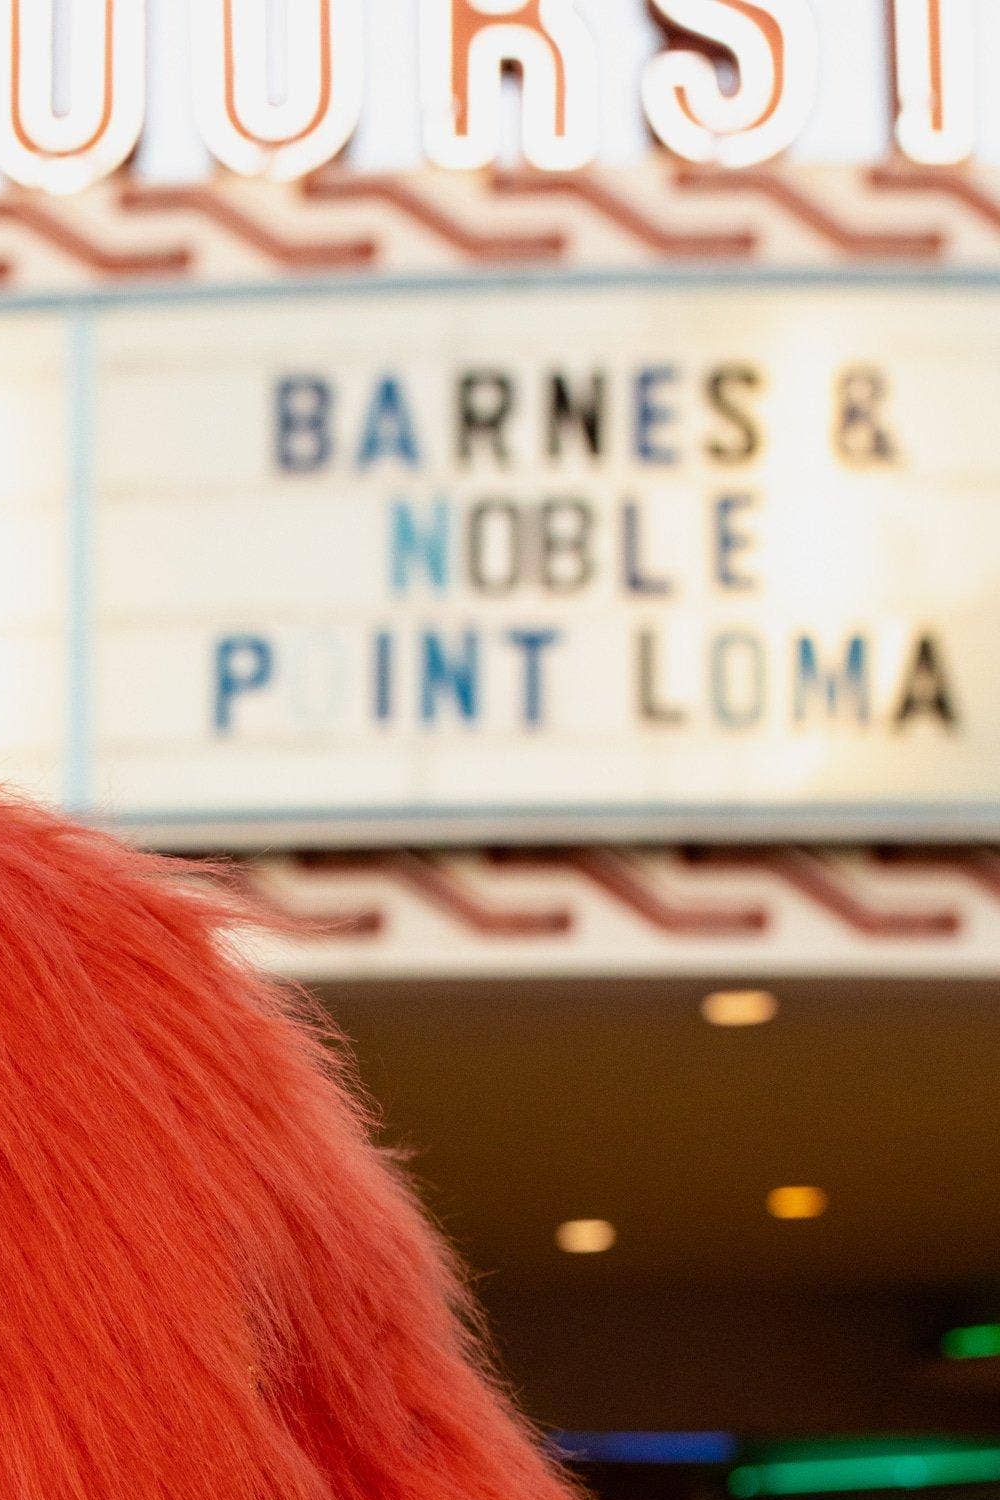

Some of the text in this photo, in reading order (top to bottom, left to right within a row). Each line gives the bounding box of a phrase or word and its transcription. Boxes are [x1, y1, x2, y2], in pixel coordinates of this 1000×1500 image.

[273, 361, 904, 473] BARNES &
[388, 492, 759, 596] NOBLE
[635, 628, 959, 732] LOMA
